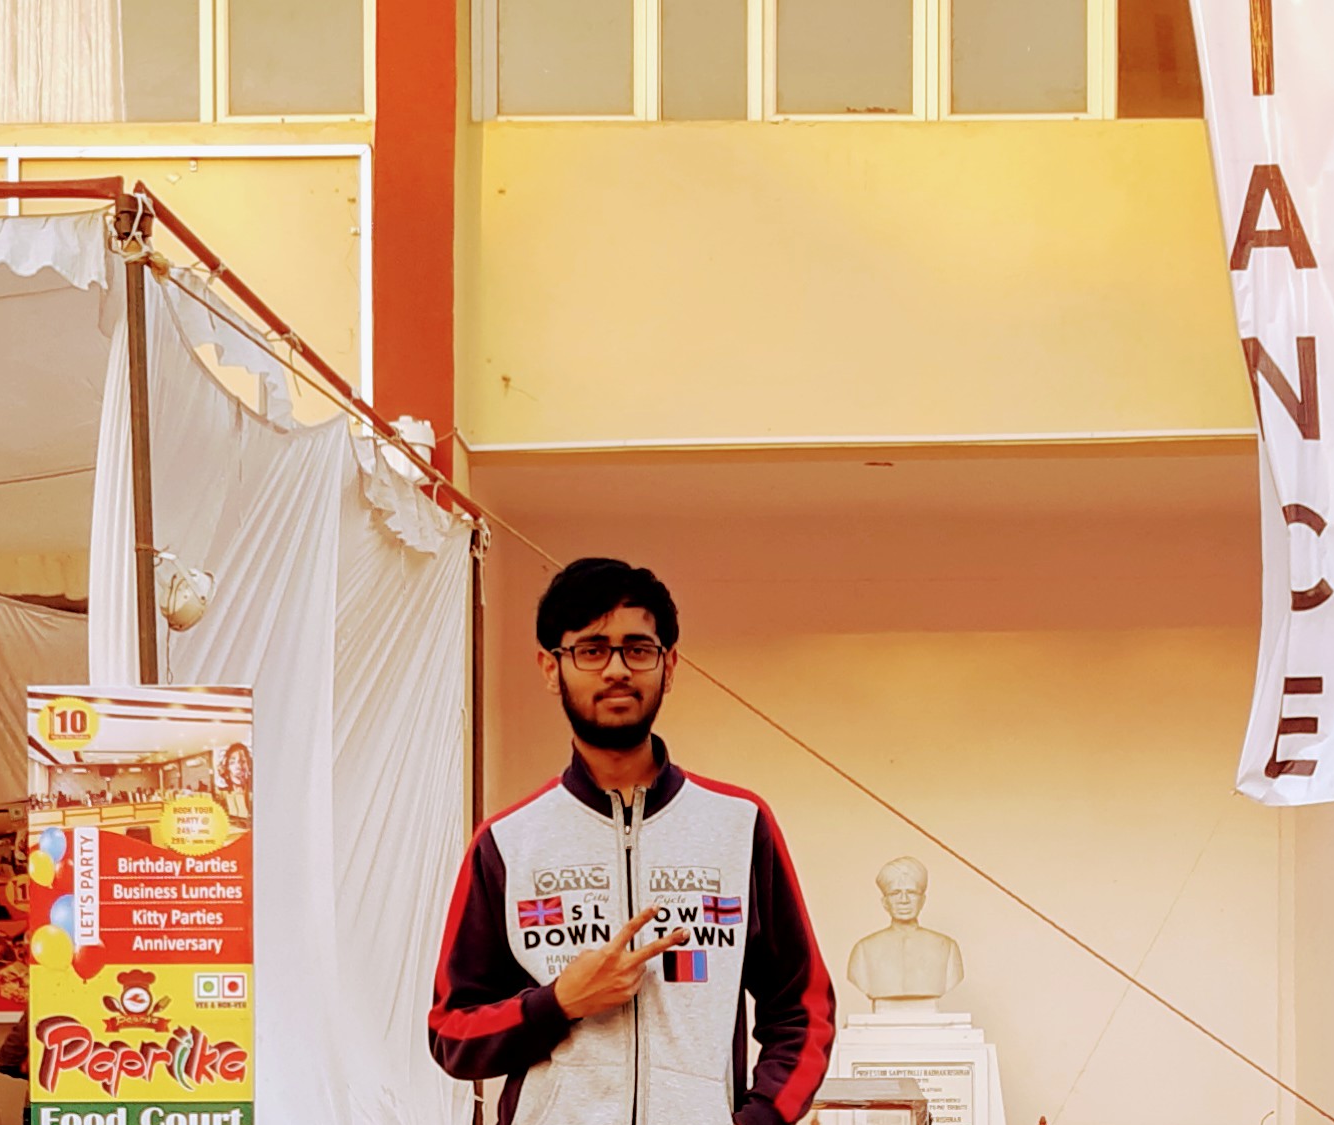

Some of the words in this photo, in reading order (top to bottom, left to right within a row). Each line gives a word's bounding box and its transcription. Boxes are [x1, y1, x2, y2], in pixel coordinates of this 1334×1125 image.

[80, 835, 95, 890] PARTY
[117, 857, 182, 876] Birthday
[186, 857, 238, 873] Parties
[113, 883, 178, 899] Business
[182, 883, 243, 899] Lunches
[132, 910, 168, 929] Kitty
[171, 910, 223, 925] Parties
[132, 936, 223, 954] Anniversary
[524, 924, 610, 950] DOWN
[35, 1015, 249, 1098] Paprika
